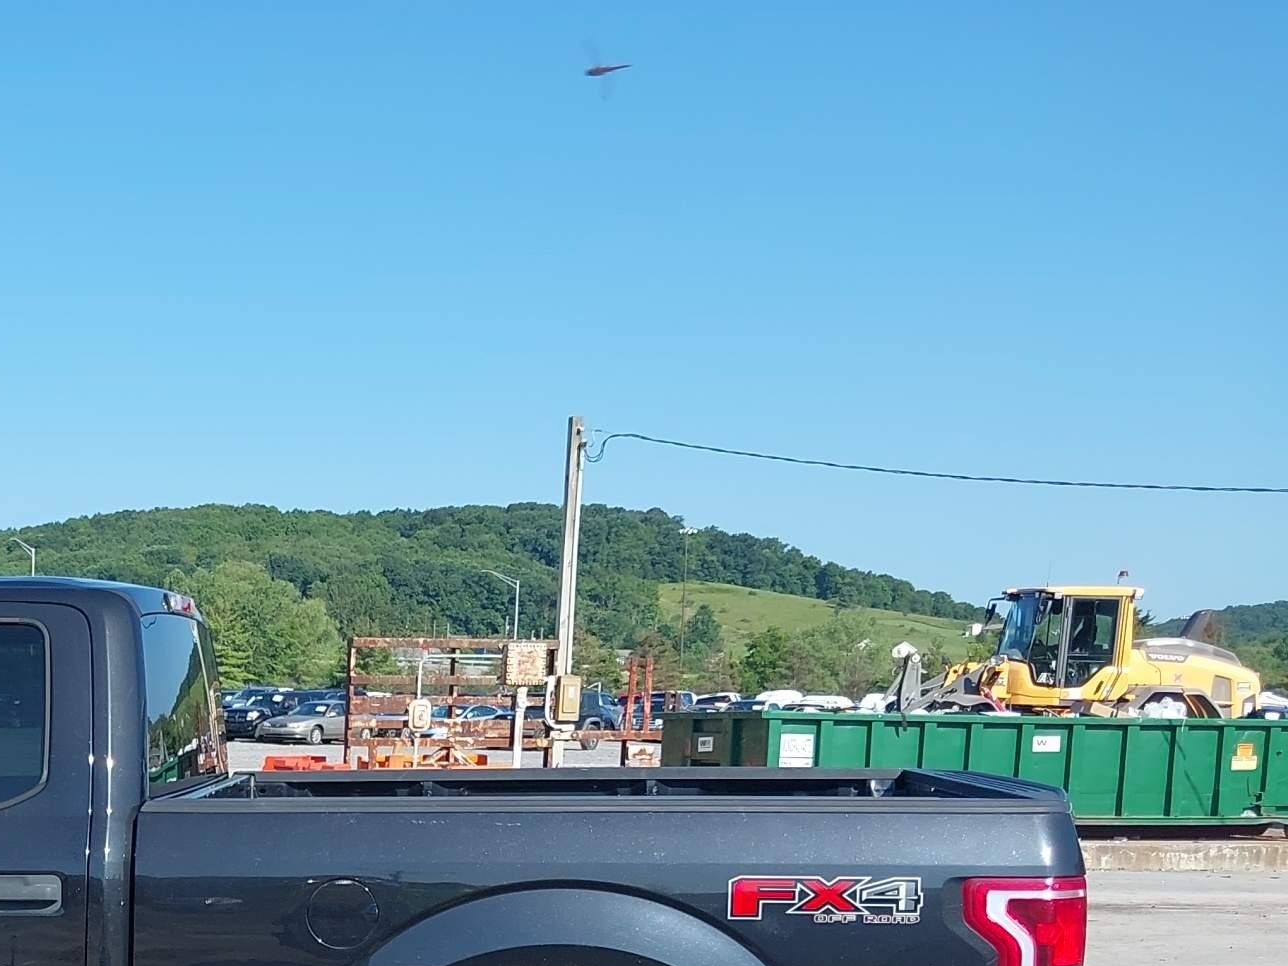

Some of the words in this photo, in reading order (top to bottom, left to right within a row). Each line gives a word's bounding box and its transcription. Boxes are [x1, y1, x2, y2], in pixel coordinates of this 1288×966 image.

[727, 875, 924, 920] FX4
[813, 913, 857, 923] OFF
[863, 913, 921, 924] ROAD
